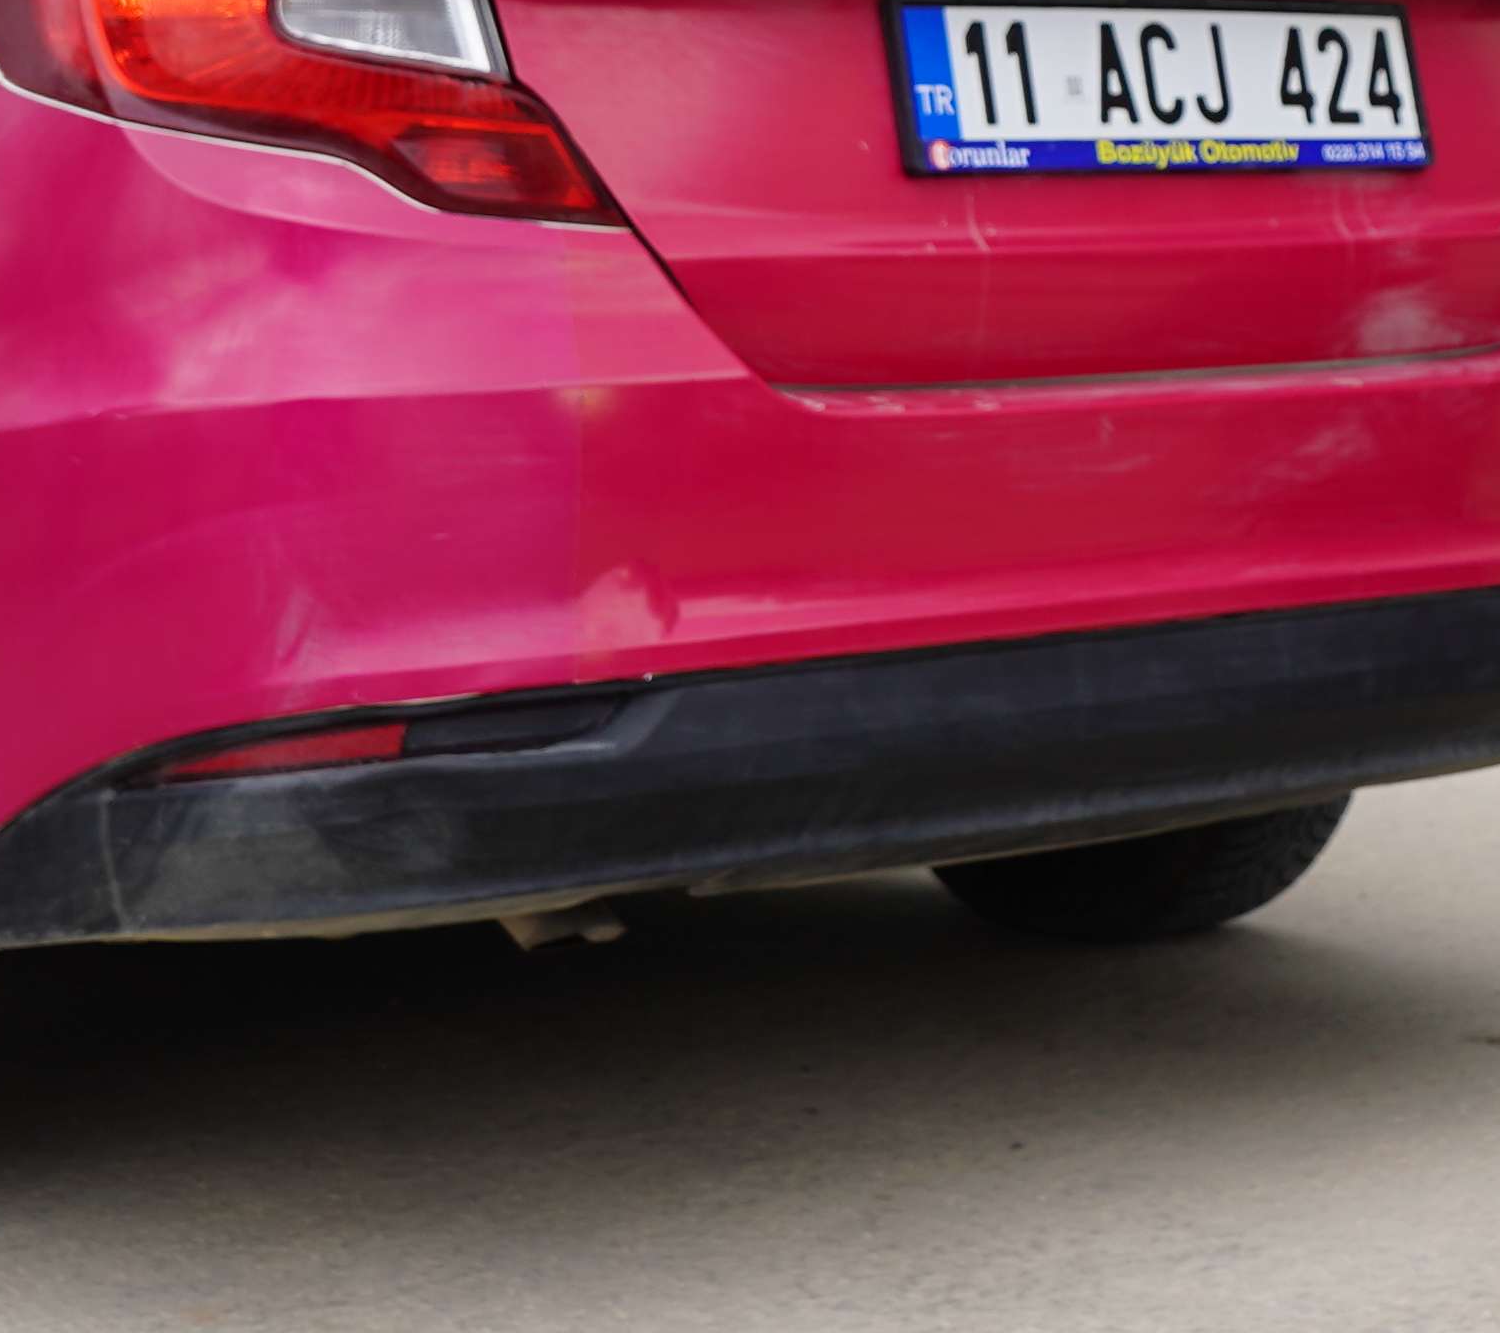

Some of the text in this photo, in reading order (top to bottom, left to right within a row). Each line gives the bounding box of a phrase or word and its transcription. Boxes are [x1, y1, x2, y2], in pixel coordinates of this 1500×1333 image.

[965, 20, 1403, 125] 11 ACJ 424
[914, 83, 955, 116] TR
[1095, 138, 1199, 170] Bozüyük
[1200, 140, 1300, 164] Otomotiv
